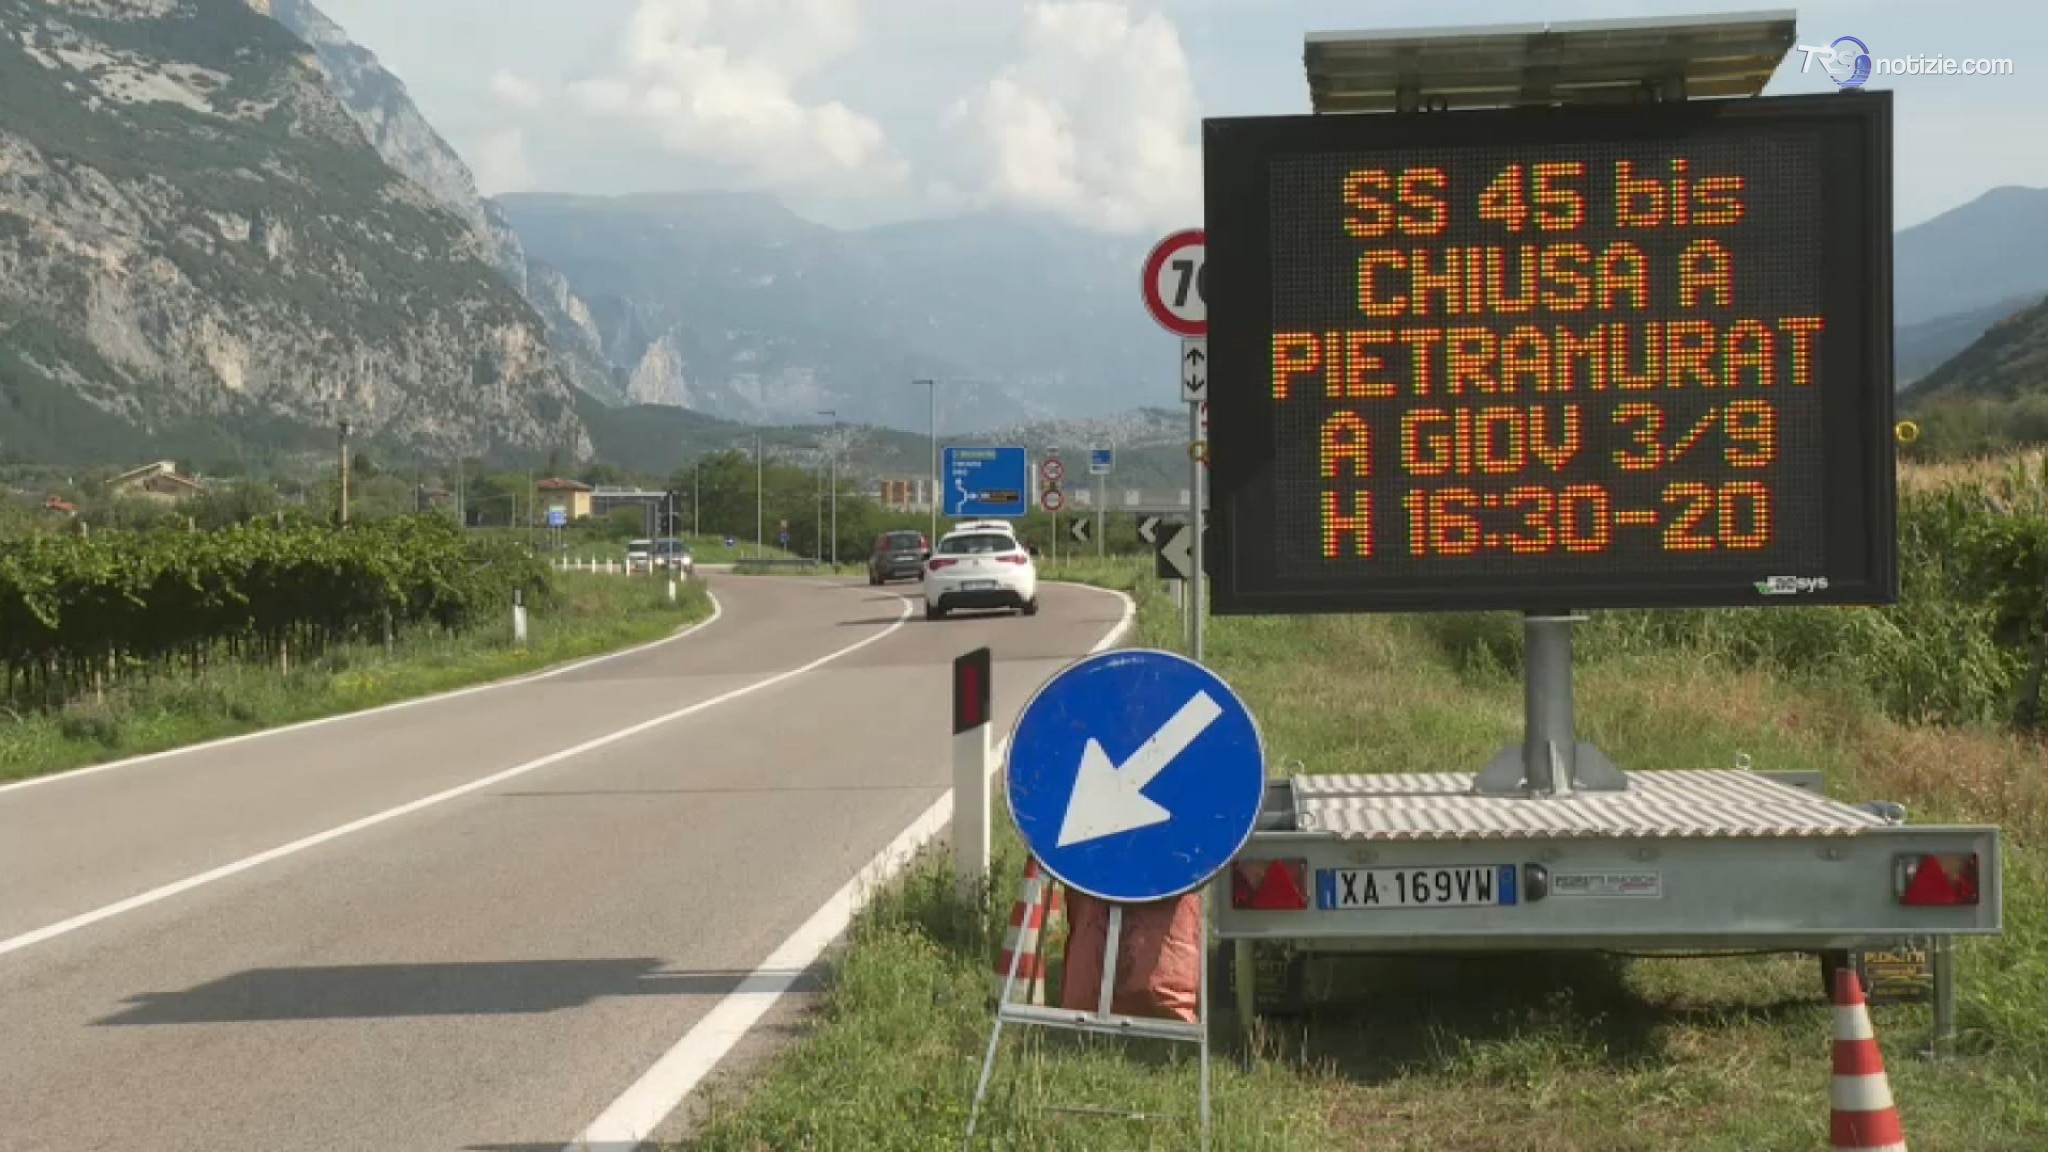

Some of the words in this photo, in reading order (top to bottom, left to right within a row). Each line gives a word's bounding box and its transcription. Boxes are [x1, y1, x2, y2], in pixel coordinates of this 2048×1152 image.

[1343, 168, 1449, 237] SS
[1479, 161, 1585, 231] 45
[1615, 158, 1745, 227] bis
[1357, 242, 1649, 317] CHIUSA
[1679, 239, 1734, 307] A
[1272, 316, 1825, 399] PIETRAMURAT
[1320, 410, 1372, 477] A
[1401, 404, 1582, 475] GIOV
[1612, 399, 1778, 471] 3/9
[1320, 490, 1373, 557] H
[1402, 481, 1773, 555] 16:30-20
[1341, 872, 1379, 905] XA
[1395, 868, 1492, 904] 169VW
